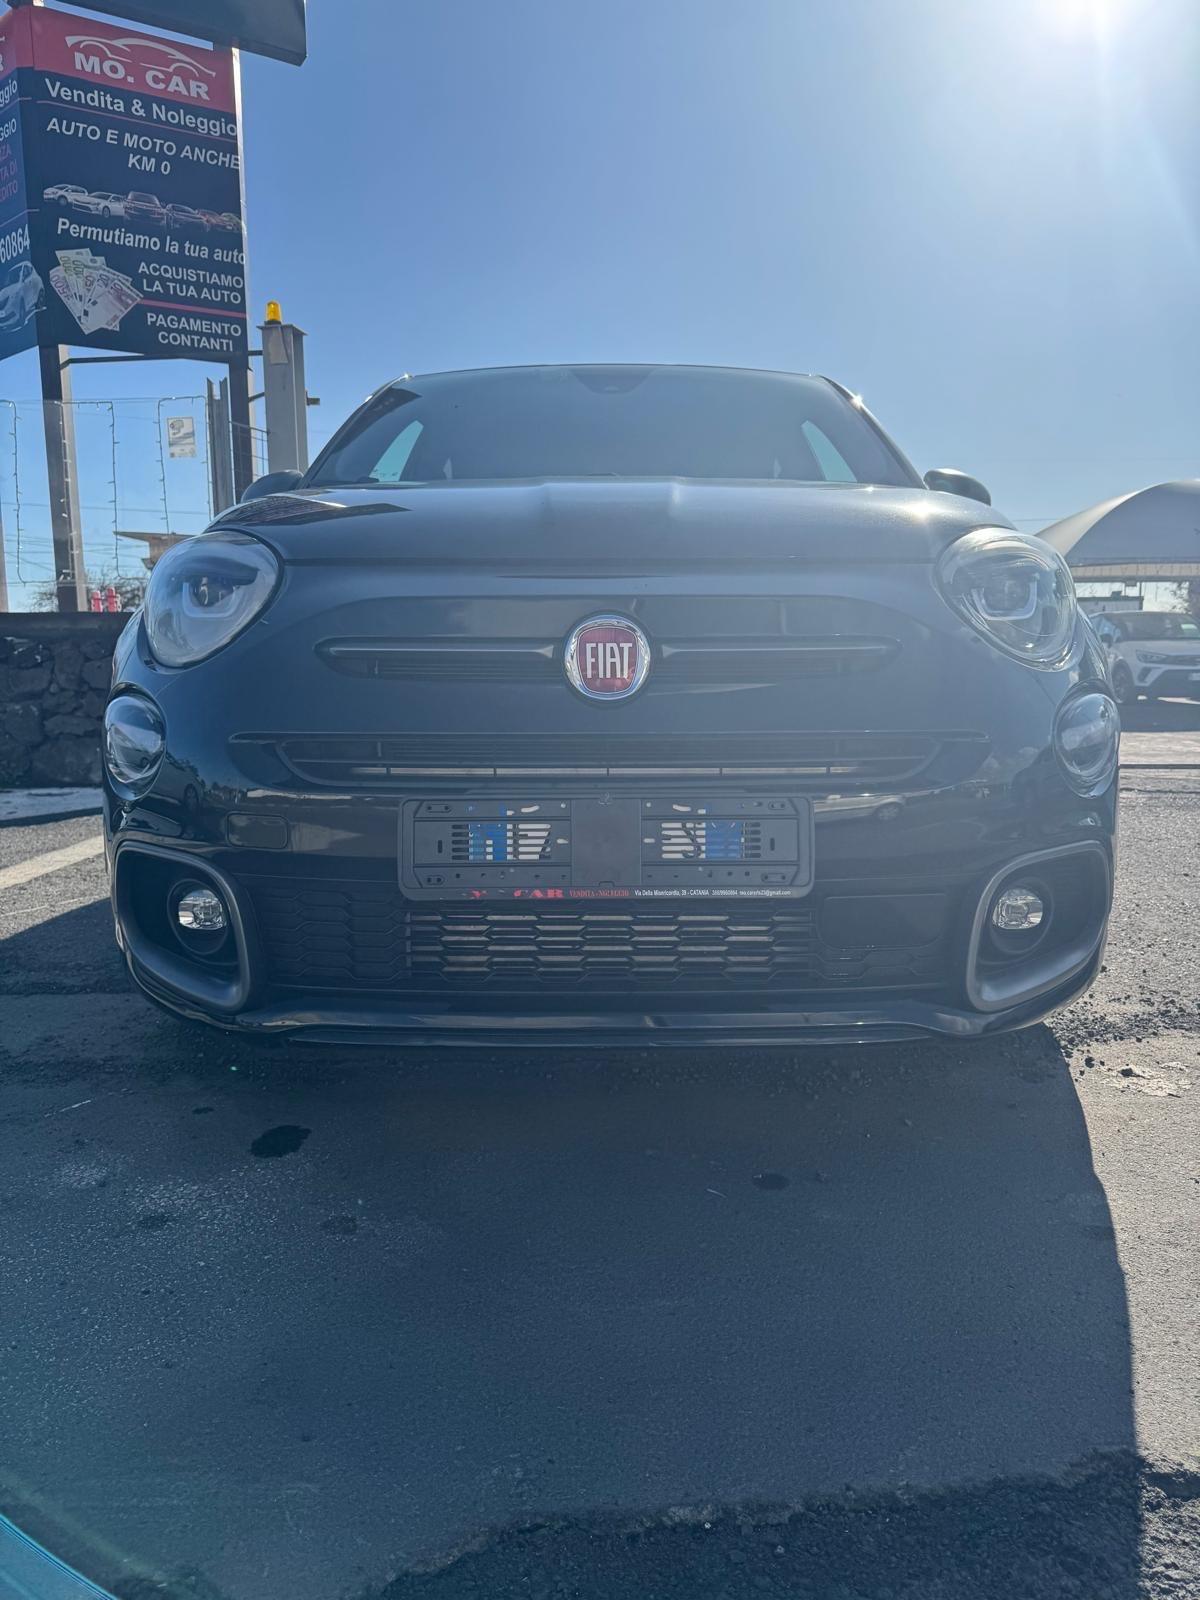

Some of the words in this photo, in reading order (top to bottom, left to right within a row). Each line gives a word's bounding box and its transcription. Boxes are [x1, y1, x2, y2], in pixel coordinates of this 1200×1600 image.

[74, 51, 134, 83] MO.
[146, 70, 210, 100] CAR
[44, 78, 125, 112] Vendita
[131, 99, 146, 117] &
[152, 103, 237, 137] Noleggio
[46, 117, 101, 141] AUTO
[106, 129, 119, 144] E
[123, 132, 177, 156] MOTO
[180, 145, 240, 169] ANCHE
[128, 153, 156, 172] KM
[161, 161, 171, 175] 0
[57, 218, 160, 250] Permutiamo
[165, 235, 179, 254] la
[184, 241, 209, 259] tua
[213, 248, 245, 265] auto
[138, 262, 243, 288] ACQUISTIAMO
[143, 279, 163, 293] LA
[166, 282, 198, 299] TUA
[201, 287, 241, 304] AUTO
[146, 312, 242, 337] PAGAMENTO
[158, 331, 233, 352] CONTANTI
[585, 642, 633, 679] FIAT
